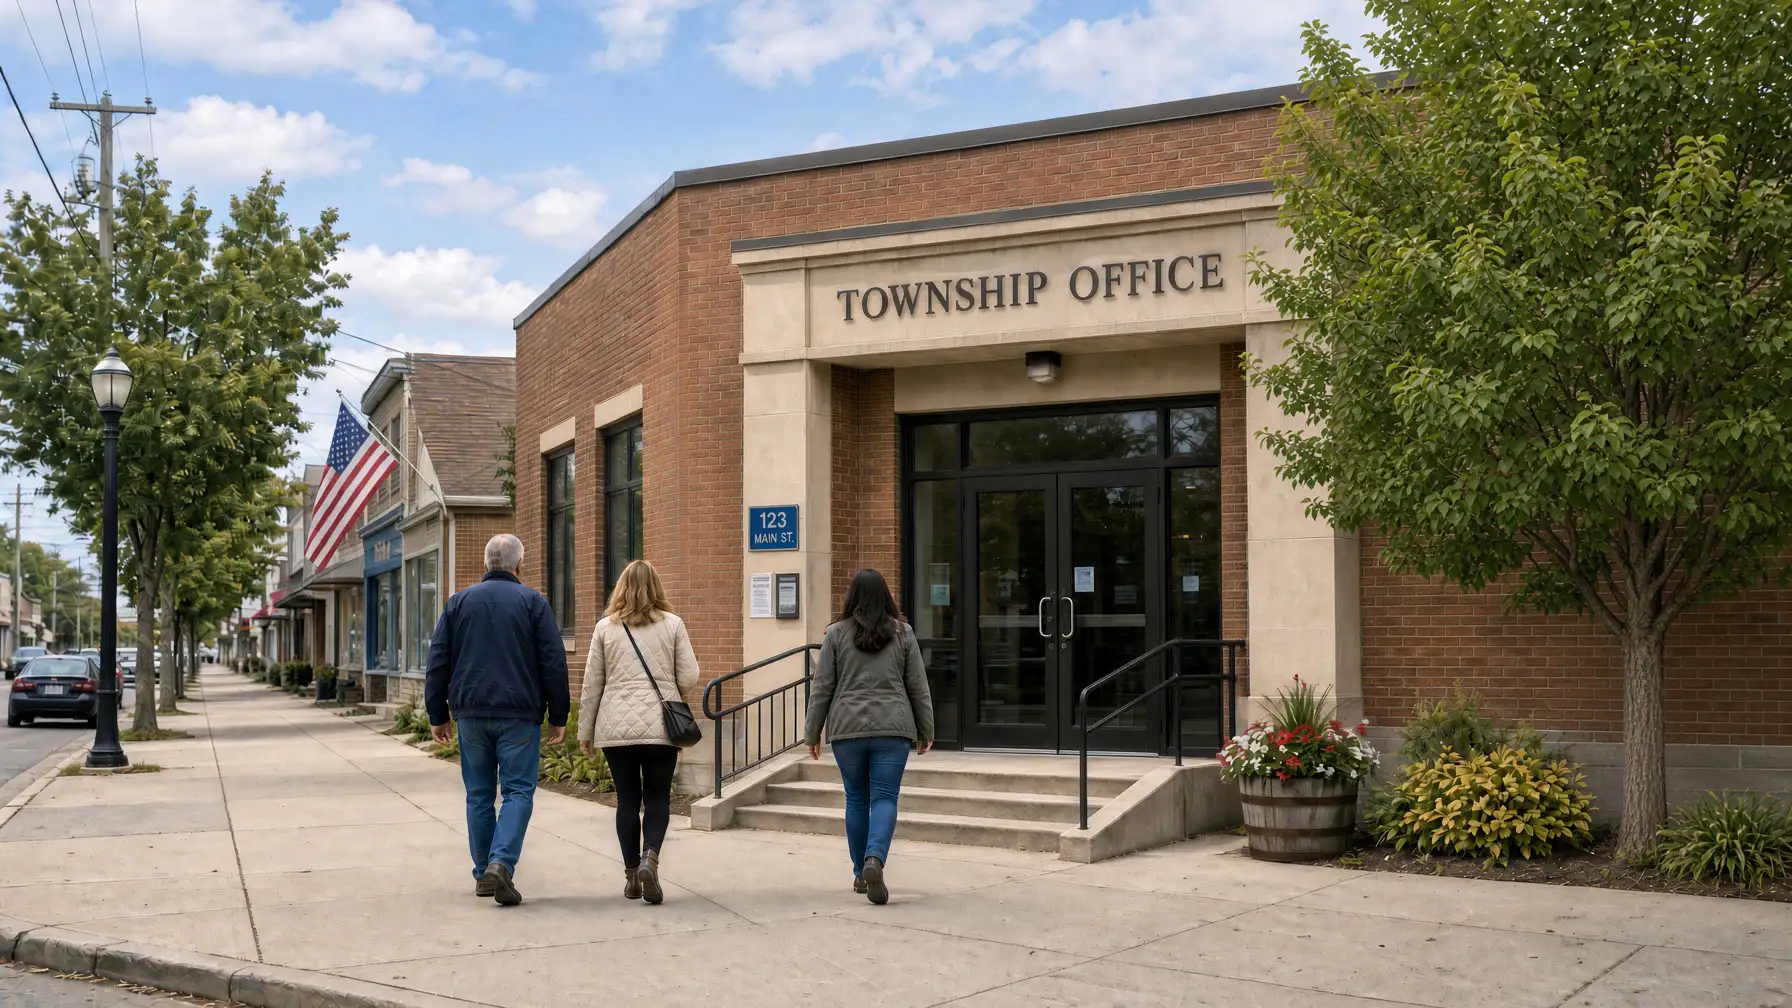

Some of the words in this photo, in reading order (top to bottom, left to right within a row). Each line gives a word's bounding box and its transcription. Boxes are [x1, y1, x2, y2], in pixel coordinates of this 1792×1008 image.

[837, 271, 1048, 322] TOWNSHIP
[1069, 253, 1224, 301] OFFICE
[760, 511, 787, 529] 123
[754, 533, 777, 544] MAIN
[780, 531, 795, 543] ST.
